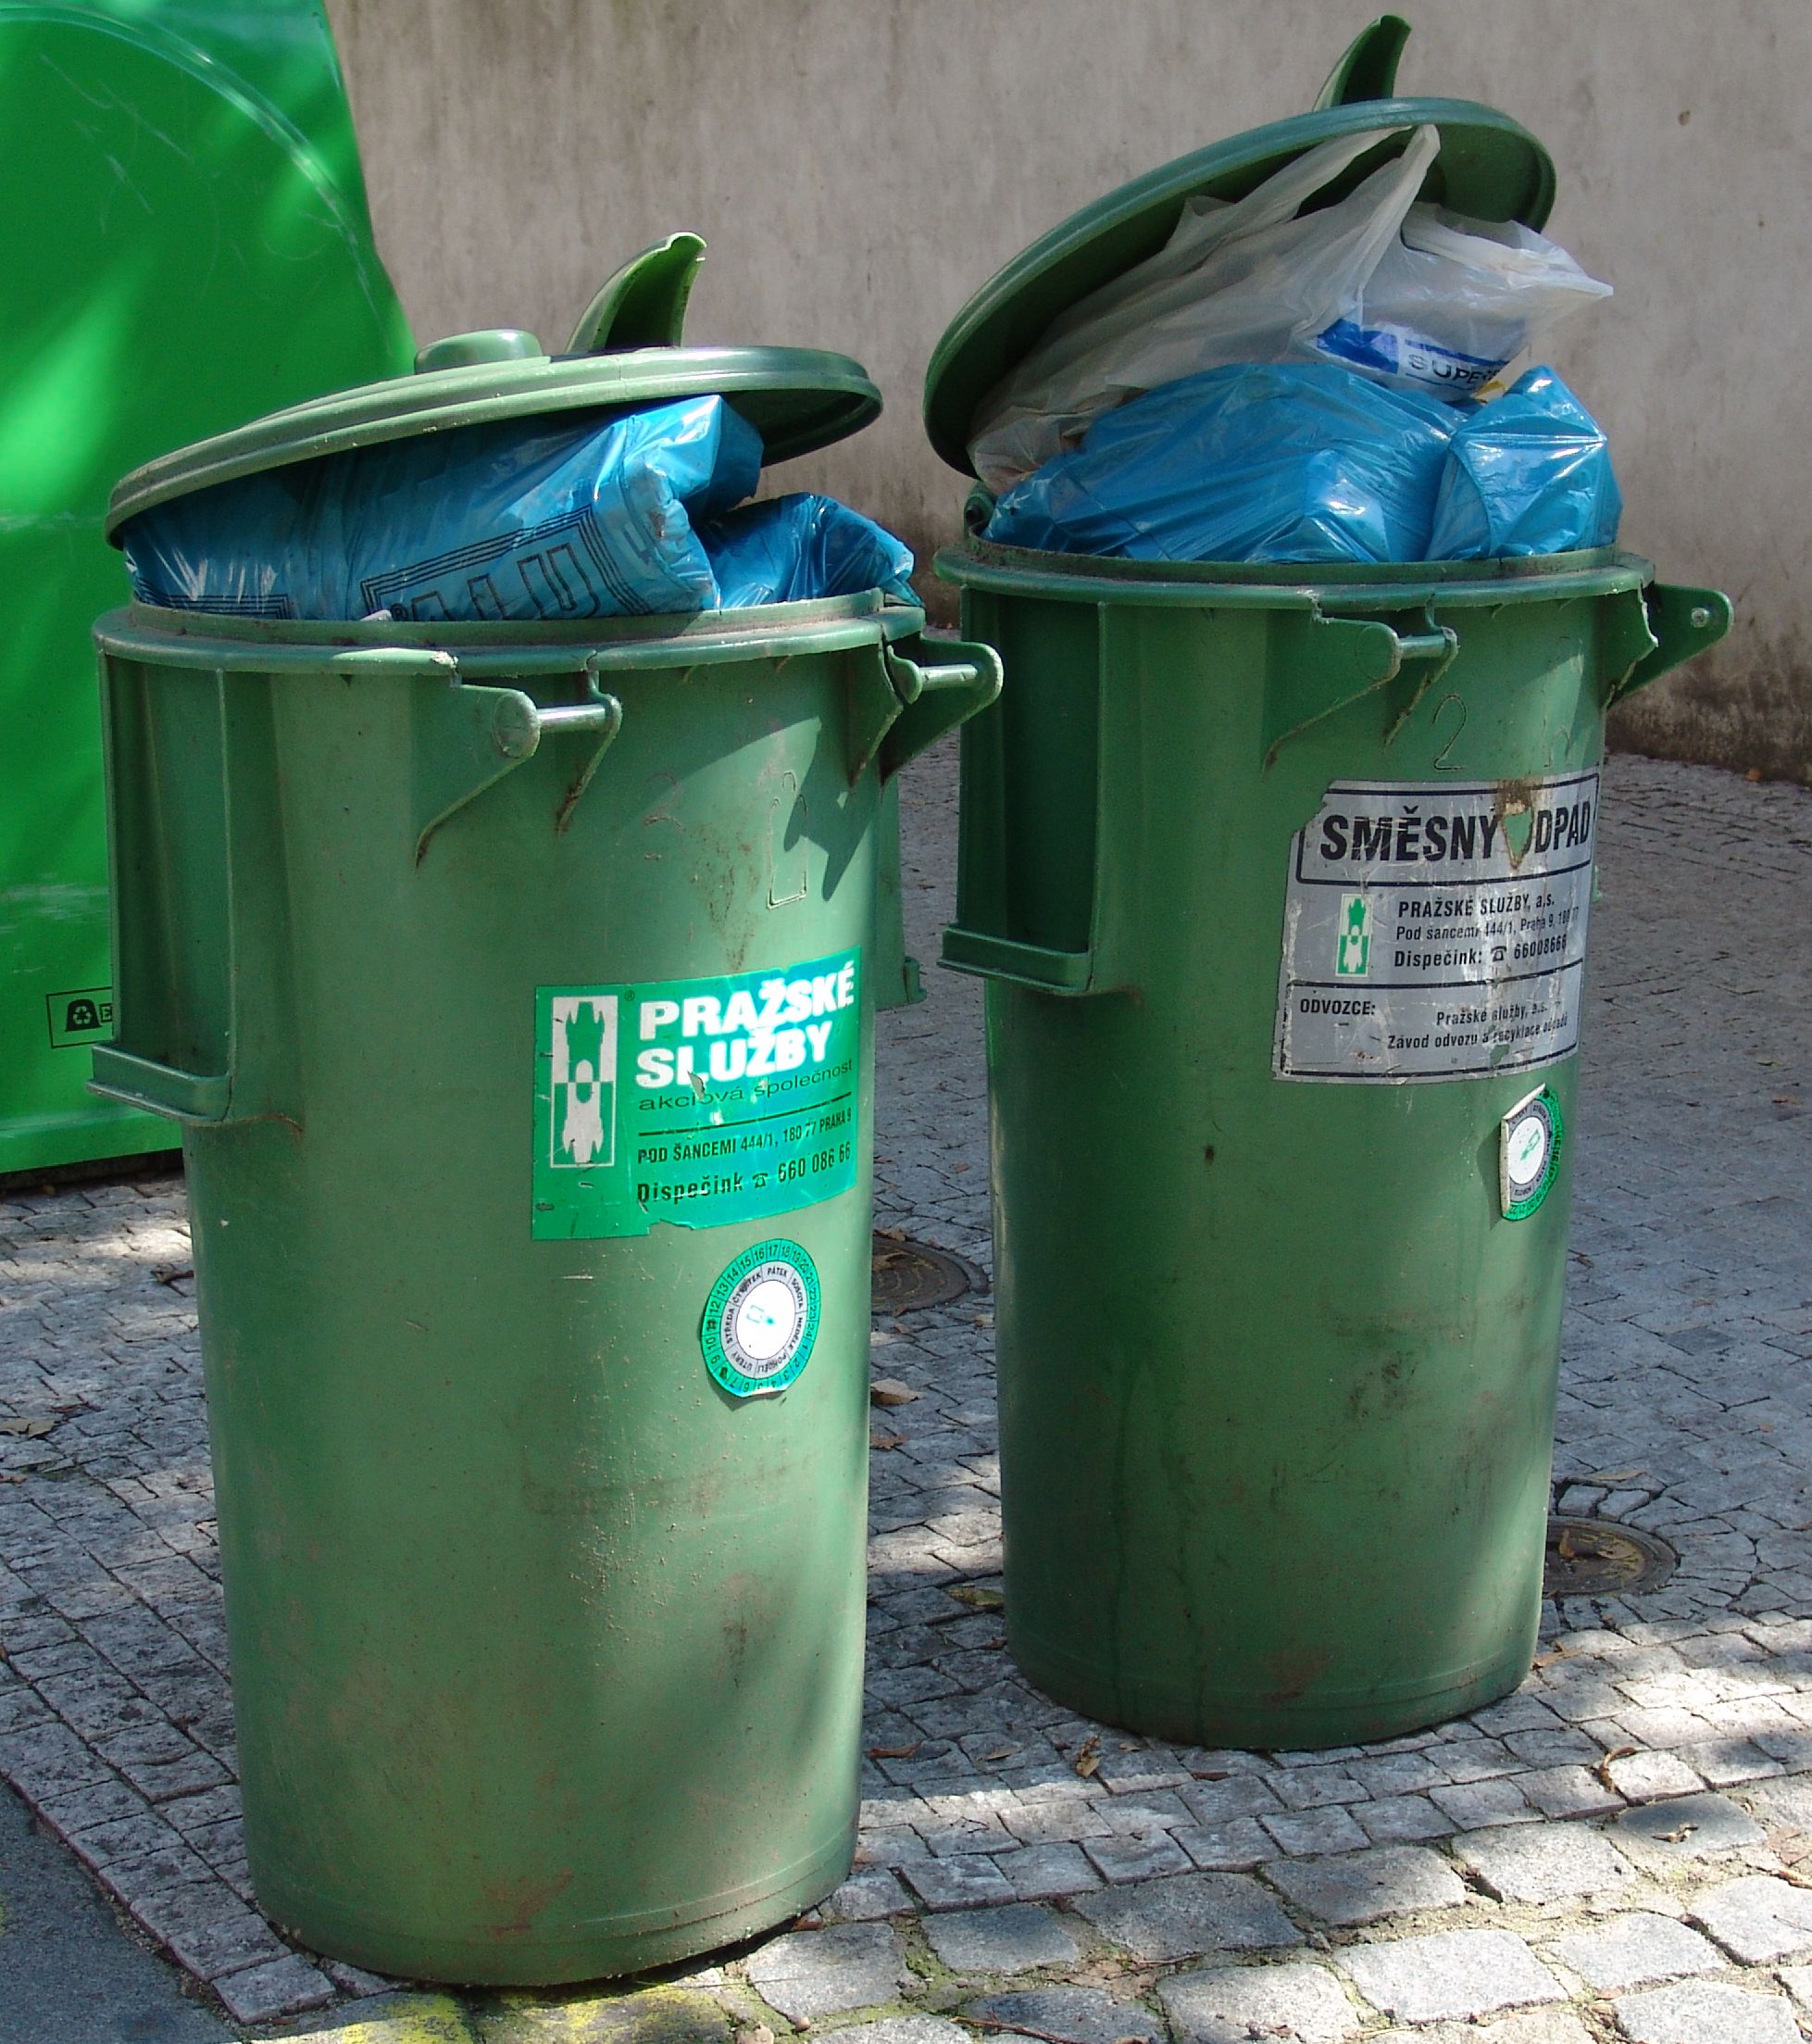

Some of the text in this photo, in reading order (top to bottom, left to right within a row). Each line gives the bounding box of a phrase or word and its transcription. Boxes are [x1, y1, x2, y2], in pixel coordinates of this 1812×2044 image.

[1525, 801, 1591, 854] DPAD
[1398, 896, 1473, 919] PRAŽSKÉ
[1480, 893, 1531, 915] SLUŽBY,
[1394, 934, 1568, 971] Dispečink: 66008666
[1396, 925, 1421, 941] Pod
[639, 960, 855, 1040] PRAŽSKÉ
[1300, 998, 1376, 1016] ODVOZCE:
[1436, 1009, 1487, 1026] Pražské
[635, 1019, 833, 1089] SLUŽBY
[1387, 1035, 1429, 1049] Závod
[1434, 1033, 1478, 1048] odvozu
[639, 1060, 853, 1111] akciová společnost
[638, 1147, 668, 1163] POD
[673, 1138, 736, 1160] ŠANCEMI
[741, 1132, 779, 1151] 444/1,
[783, 1123, 802, 1143] 180
[819, 1110, 845, 1133] PRAHA
[637, 1140, 851, 1204] Dispečink 660 086 66
[709, 1300, 721, 1315] 12
[717, 1283, 729, 1297] 13
[726, 1267, 739, 1282] 14
[740, 1256, 752, 1270] 15
[754, 1247, 765, 1260] 16
[768, 1244, 779, 1258] 17
